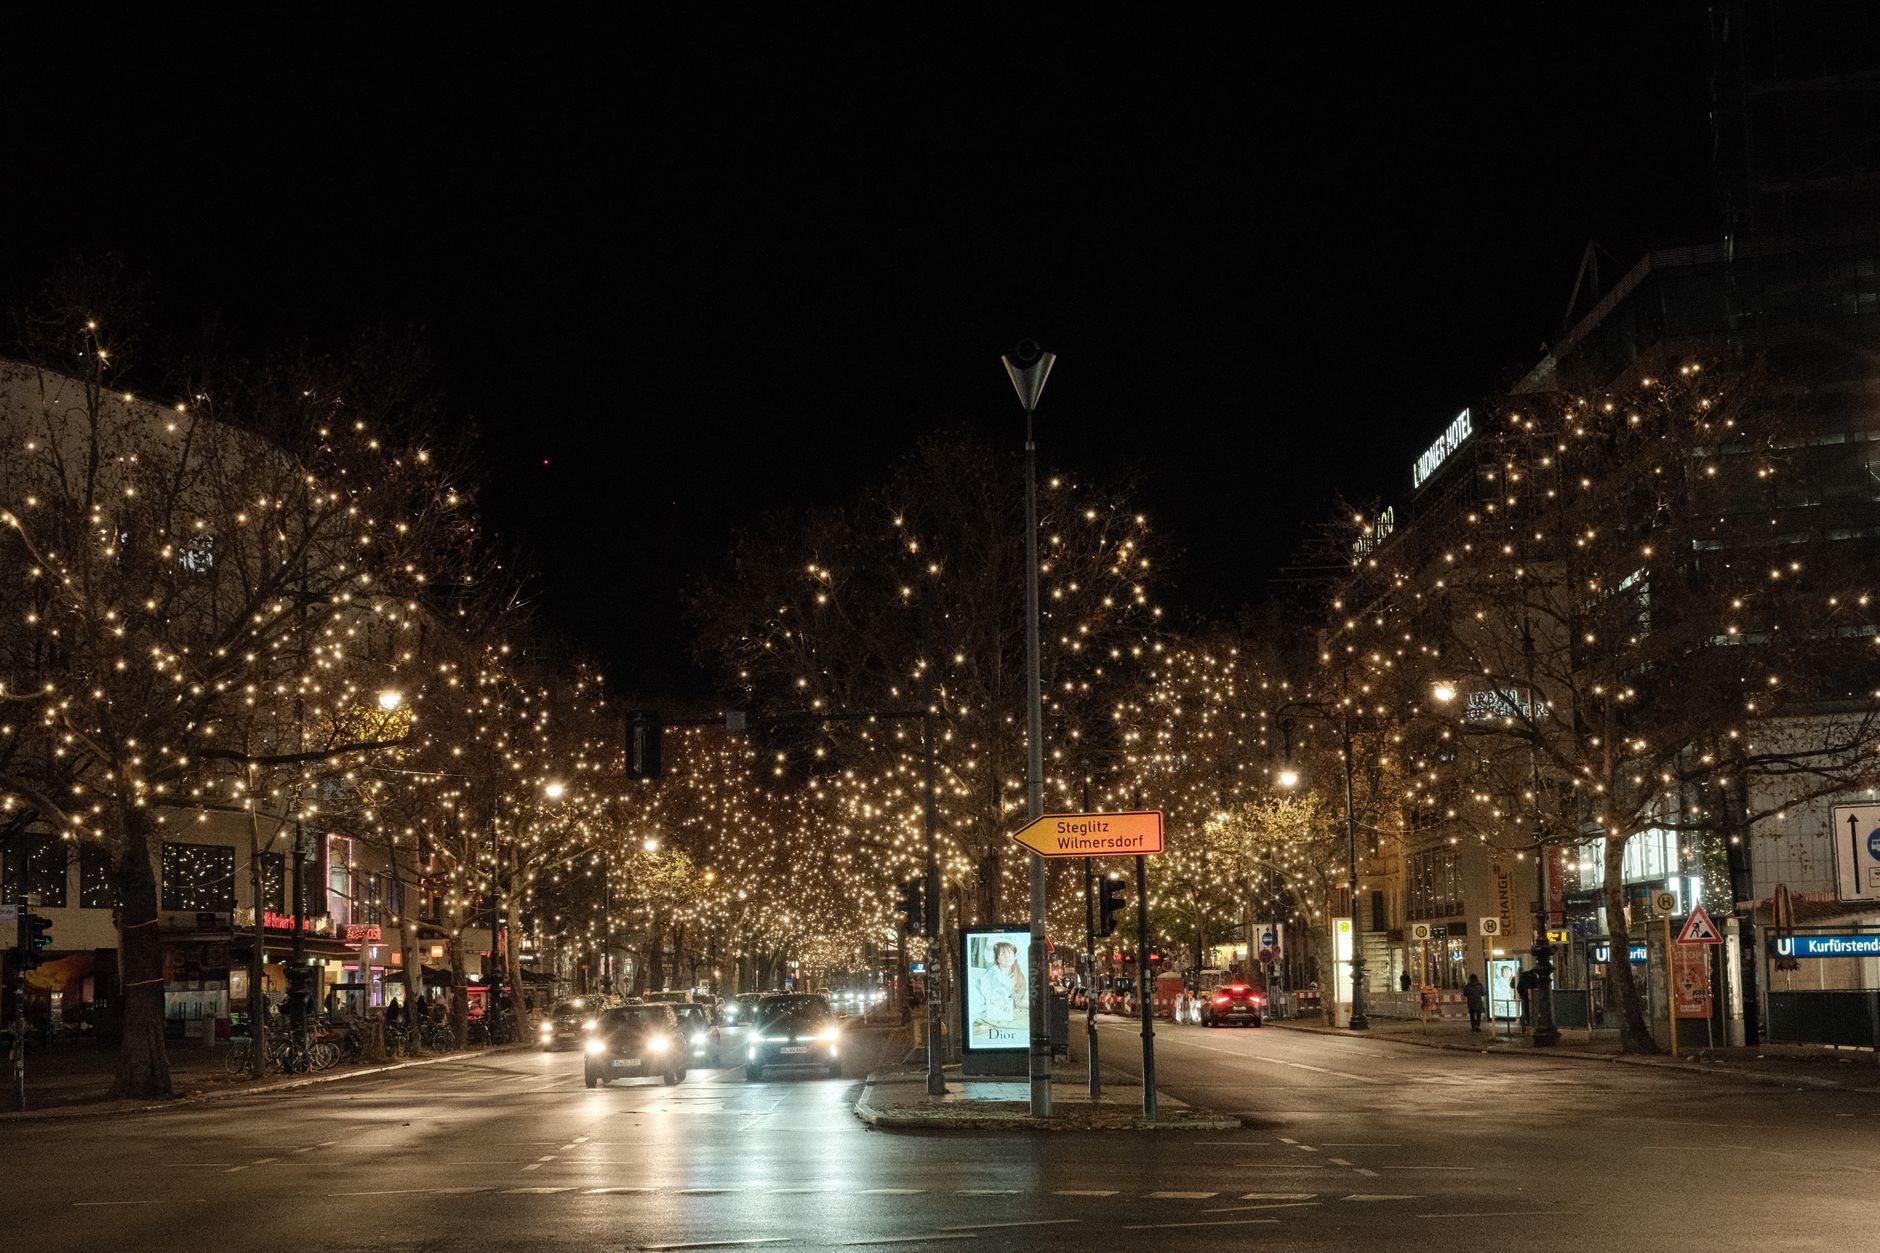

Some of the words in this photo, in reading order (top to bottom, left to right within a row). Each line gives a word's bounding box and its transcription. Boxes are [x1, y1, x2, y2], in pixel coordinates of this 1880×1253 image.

[1446, 407, 1472, 456] HOTEL
[1057, 821, 1109, 835] Steglitz
[1057, 835, 1144, 849] Wilmersdorf
[1777, 938, 1791, 955] U
[1595, 947, 1607, 962] U
[989, 1028, 1016, 1039] Dior
